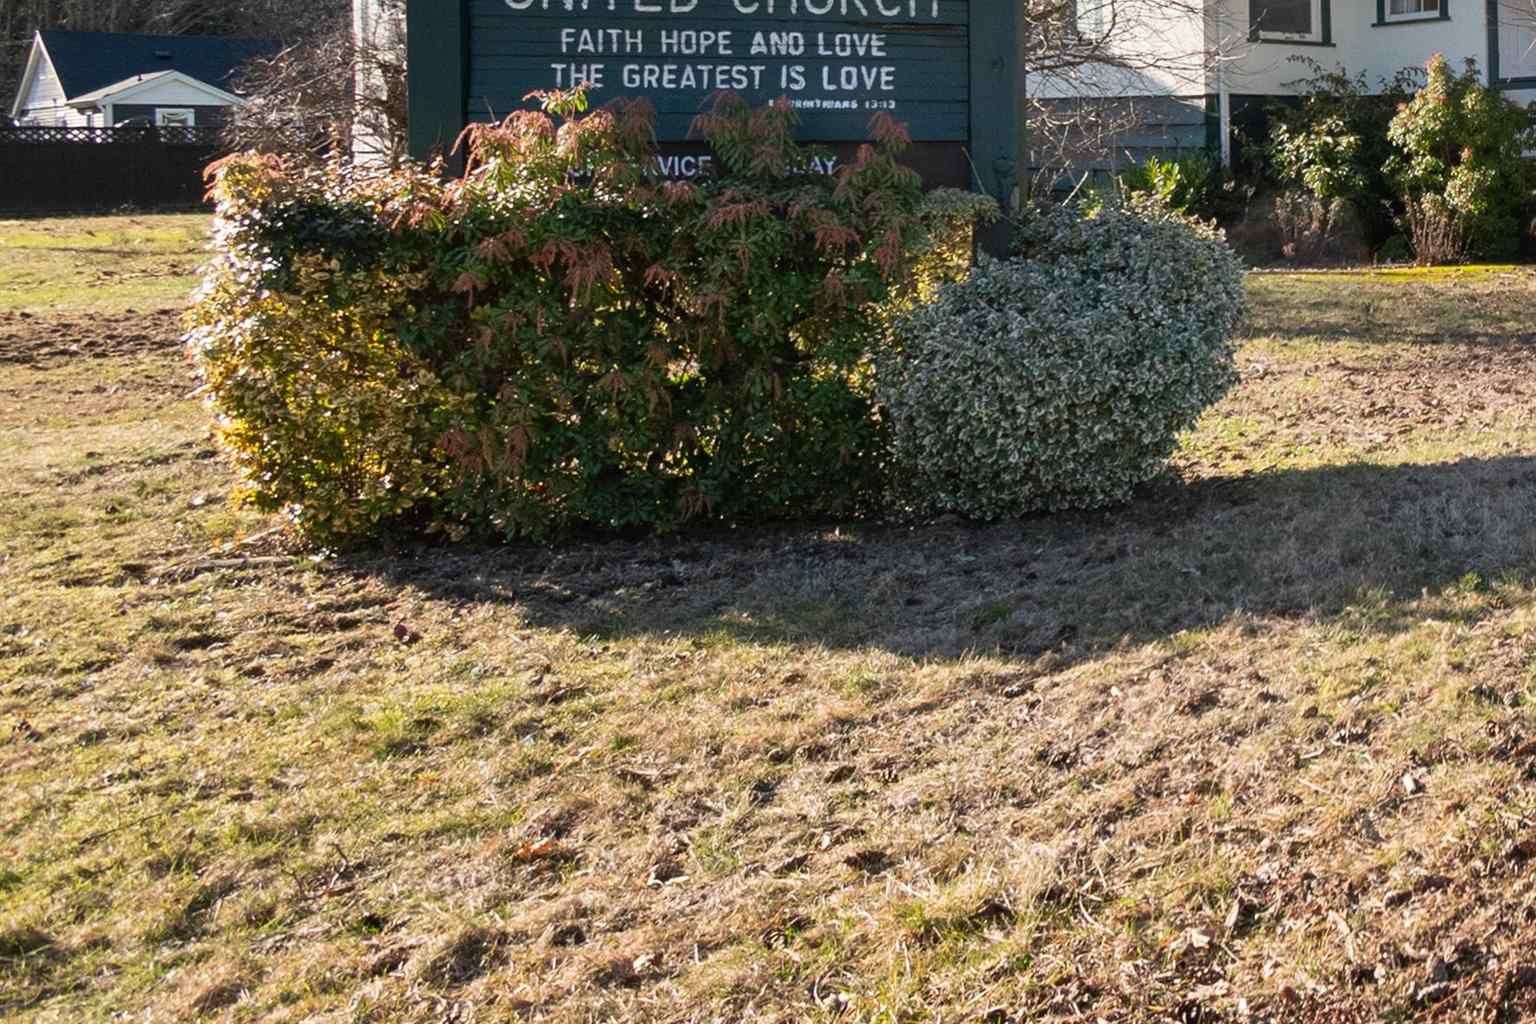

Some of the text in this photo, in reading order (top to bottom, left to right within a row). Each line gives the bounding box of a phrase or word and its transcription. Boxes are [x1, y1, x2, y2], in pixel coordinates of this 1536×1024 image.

[561, 28, 887, 57] FAITH HOPE AND LOVE
[551, 63, 896, 91] THE GREATEST IS LOVE
